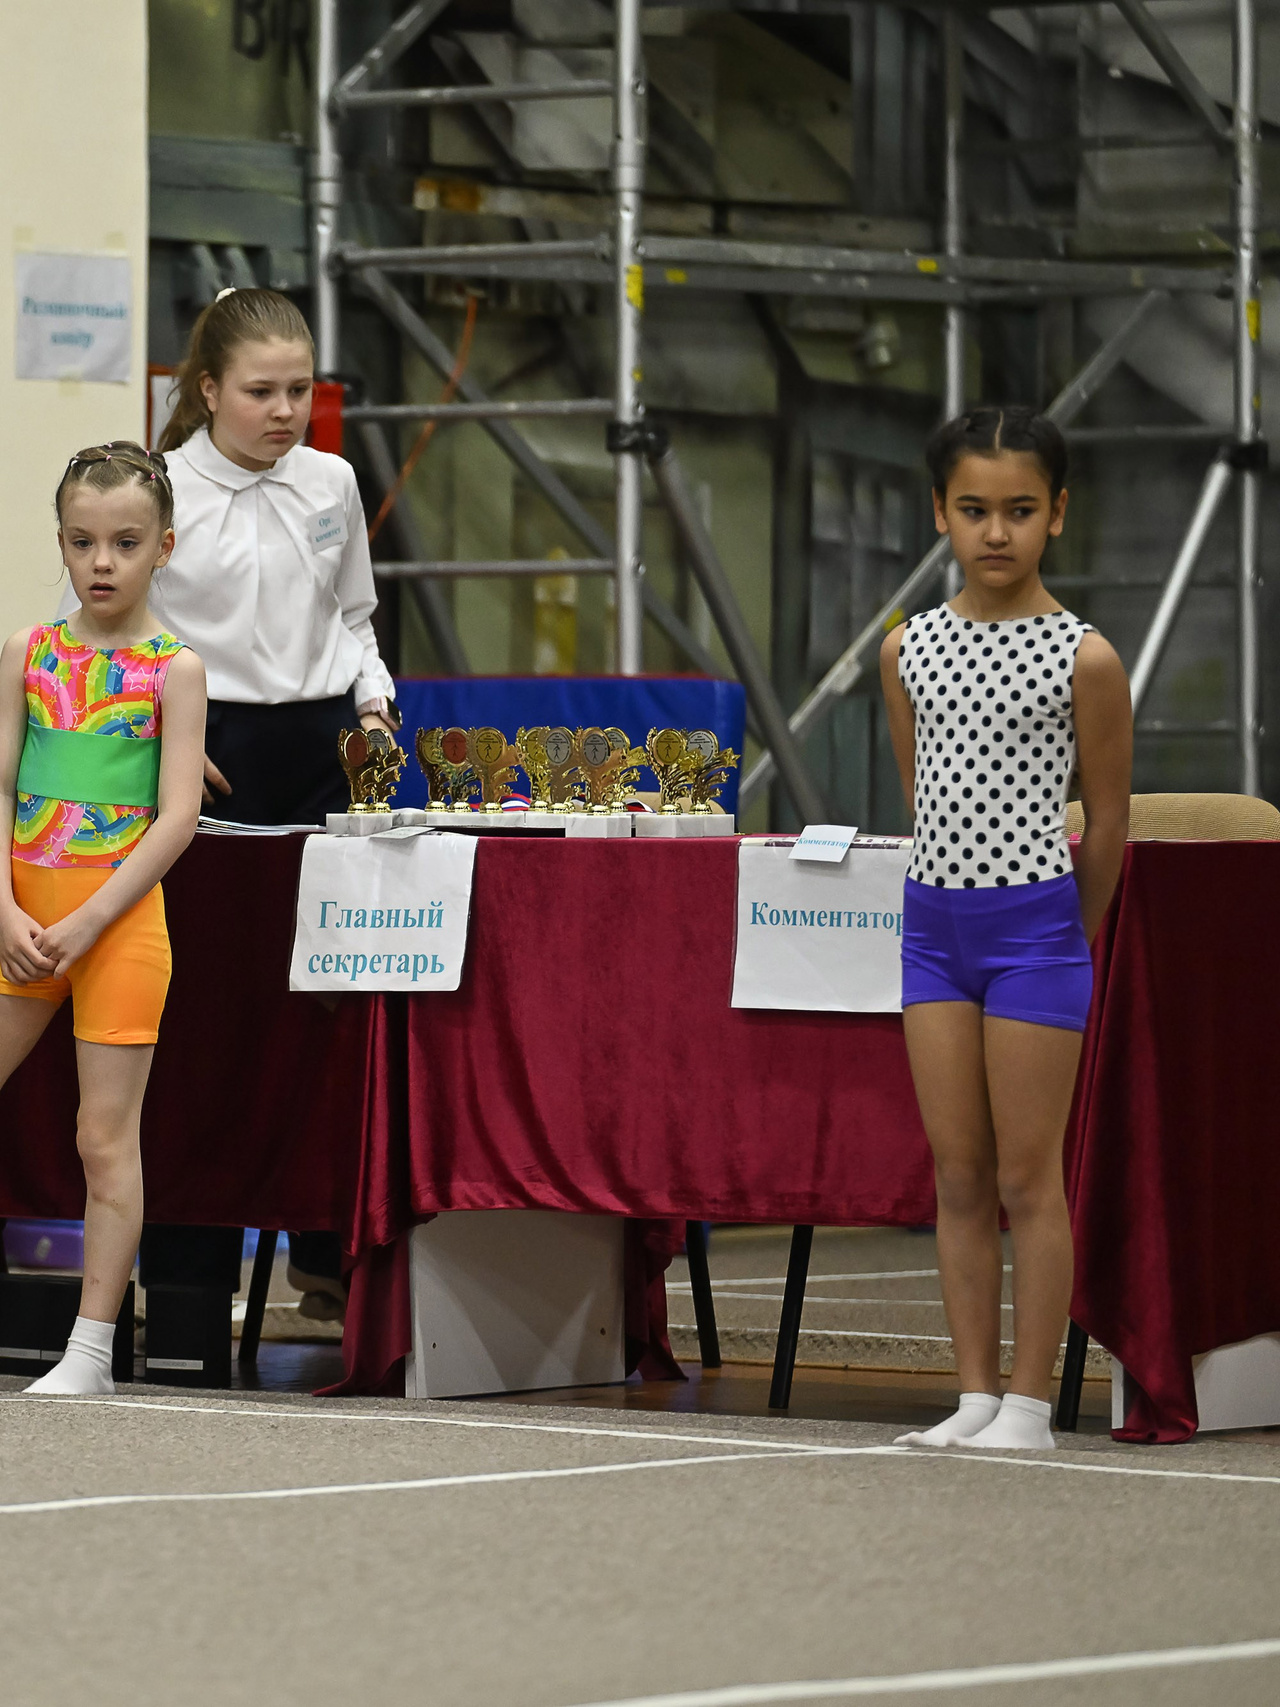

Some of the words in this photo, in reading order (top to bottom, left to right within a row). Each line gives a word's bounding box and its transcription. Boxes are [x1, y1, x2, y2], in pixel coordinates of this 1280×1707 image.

[798, 837, 849, 850] Комментатор
[317, 900, 445, 929] Главный
[750, 901, 904, 937] Комментатор
[307, 953, 445, 982] секретарь
